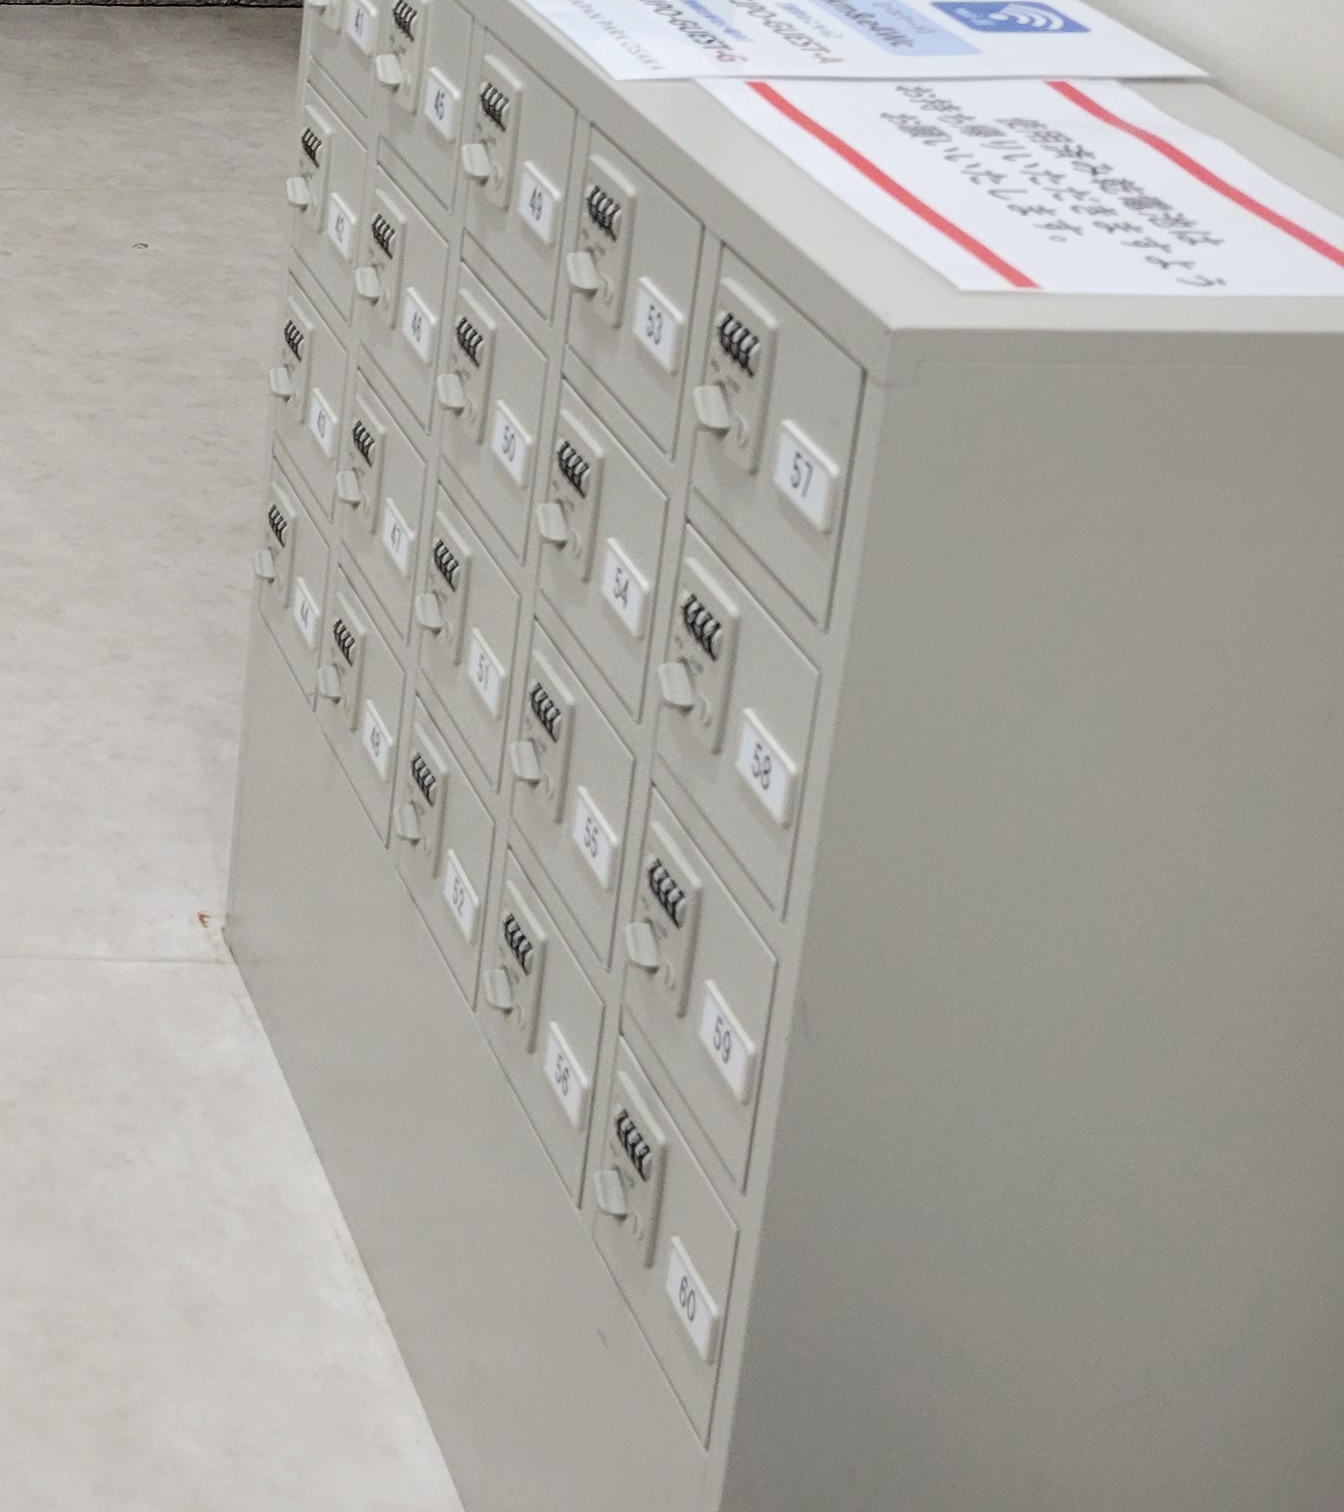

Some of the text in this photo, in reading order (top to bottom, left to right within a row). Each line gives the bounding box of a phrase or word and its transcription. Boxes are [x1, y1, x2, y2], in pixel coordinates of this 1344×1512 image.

[433, 91, 445, 122] 45
[880, 112, 1084, 243] お願いいたします。
[896, 85, 1227, 286] お持ち帰りいただきますよう
[529, 189, 544, 221] 49
[646, 304, 663, 346] 53
[789, 450, 814, 498] 57
[613, 567, 629, 610] 54
[477, 655, 490, 691] 51
[751, 743, 772, 791] 58
[583, 817, 599, 858] 55
[451, 882, 465, 917] 52
[713, 1015, 732, 1065] 59
[554, 1053, 570, 1097] 56
[679, 1274, 697, 1323] 60
